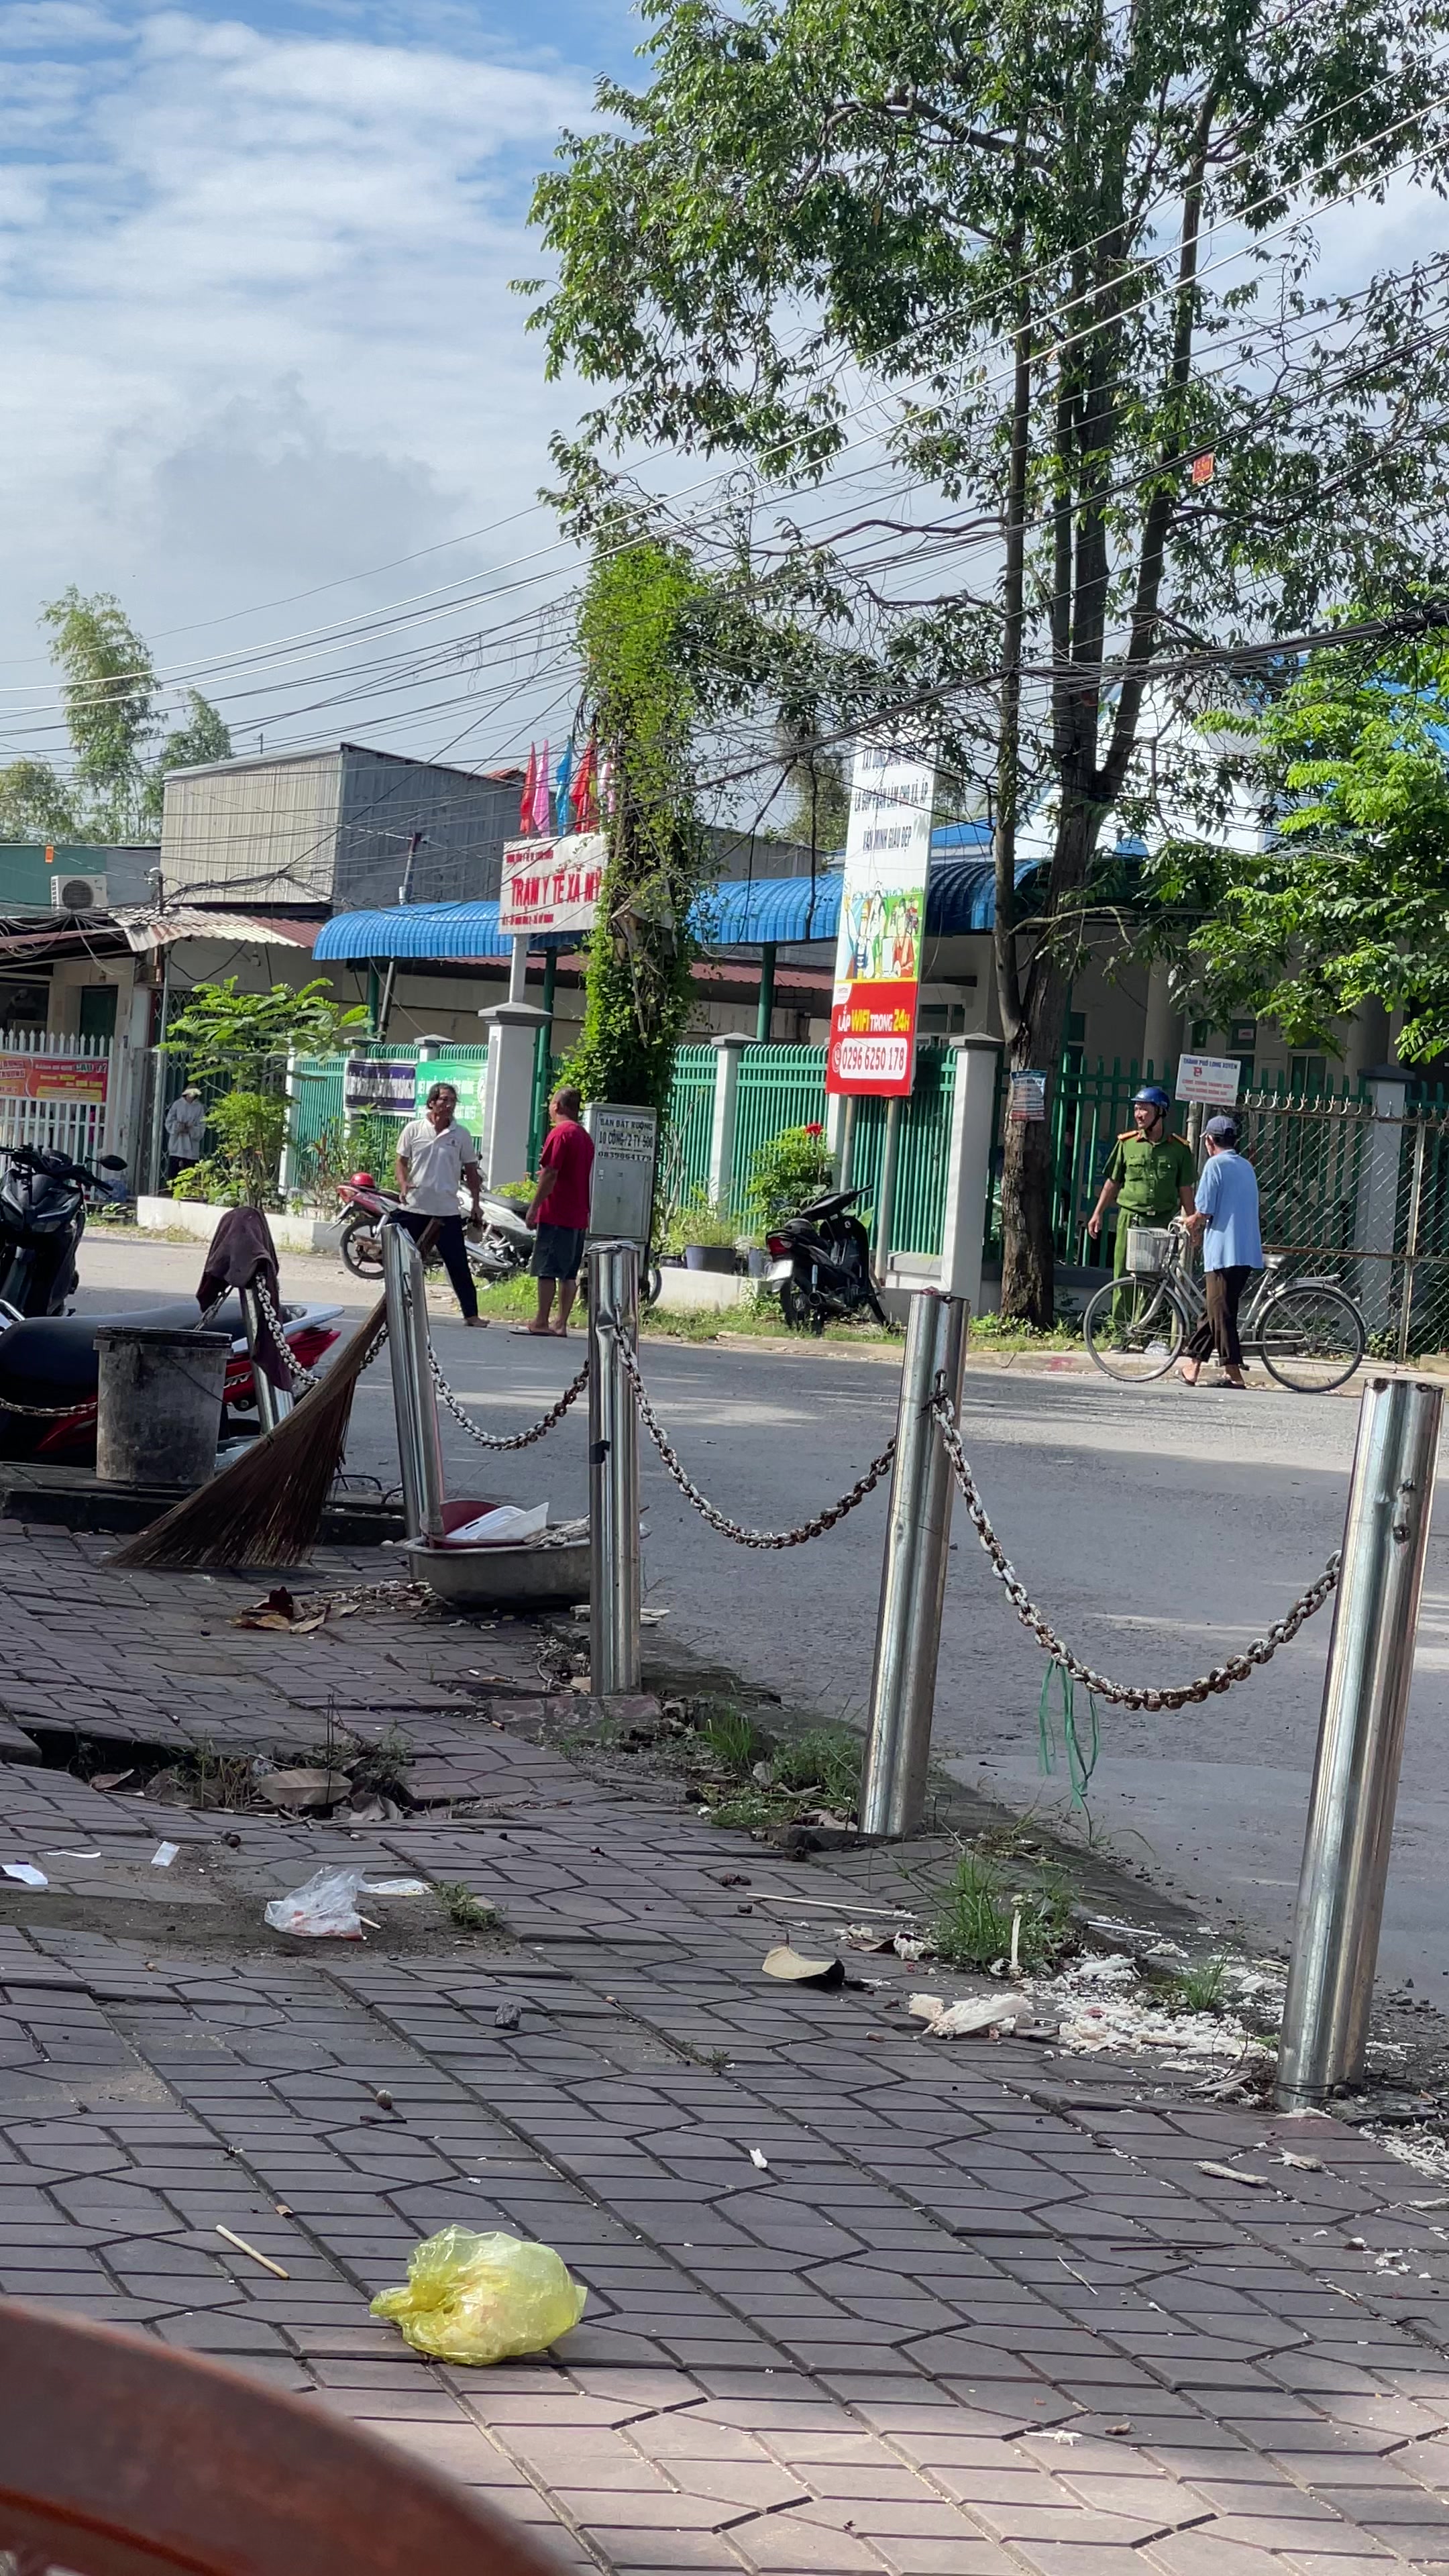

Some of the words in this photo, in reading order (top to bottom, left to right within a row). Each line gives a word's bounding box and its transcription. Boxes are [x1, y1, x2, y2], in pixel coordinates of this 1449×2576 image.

[873, 828, 888, 850] MINH
[512, 877, 540, 913] TRẠM
[542, 876, 549, 905] Y
[553, 867, 565, 904] TẾ
[837, 1005, 851, 1032] LẮP
[851, 1009, 870, 1032] WIFI
[870, 1014, 894, 1032] TRONG
[842, 1046, 862, 1070] 0296
[865, 1046, 886, 1071] 6250
[888, 1047, 904, 1071] 178
